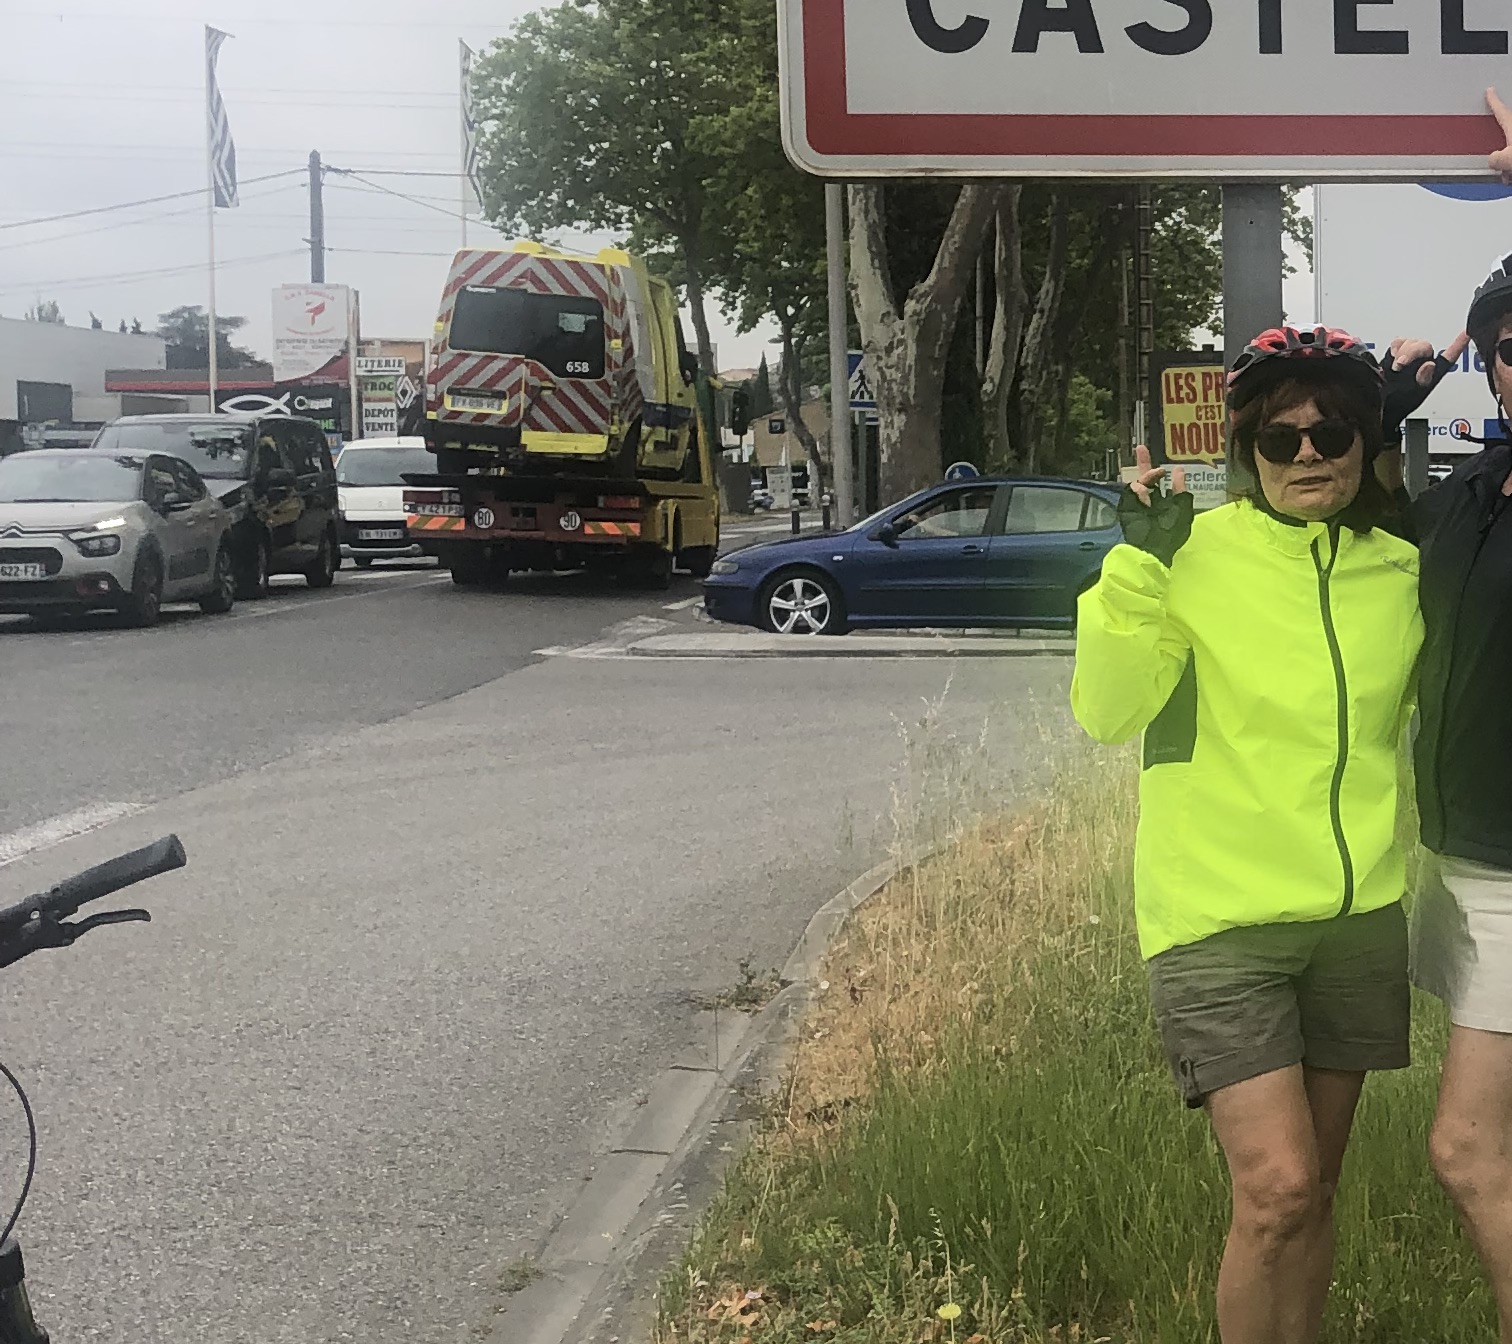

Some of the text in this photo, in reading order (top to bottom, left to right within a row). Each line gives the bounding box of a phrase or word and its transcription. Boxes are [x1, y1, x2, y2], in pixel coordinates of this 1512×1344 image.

[357, 359, 404, 368] LITERIE
[565, 361, 590, 373] 658
[1164, 371, 1225, 404] LES PR
[1195, 405, 1222, 421] C'EST
[364, 422, 396, 432] VENTE
